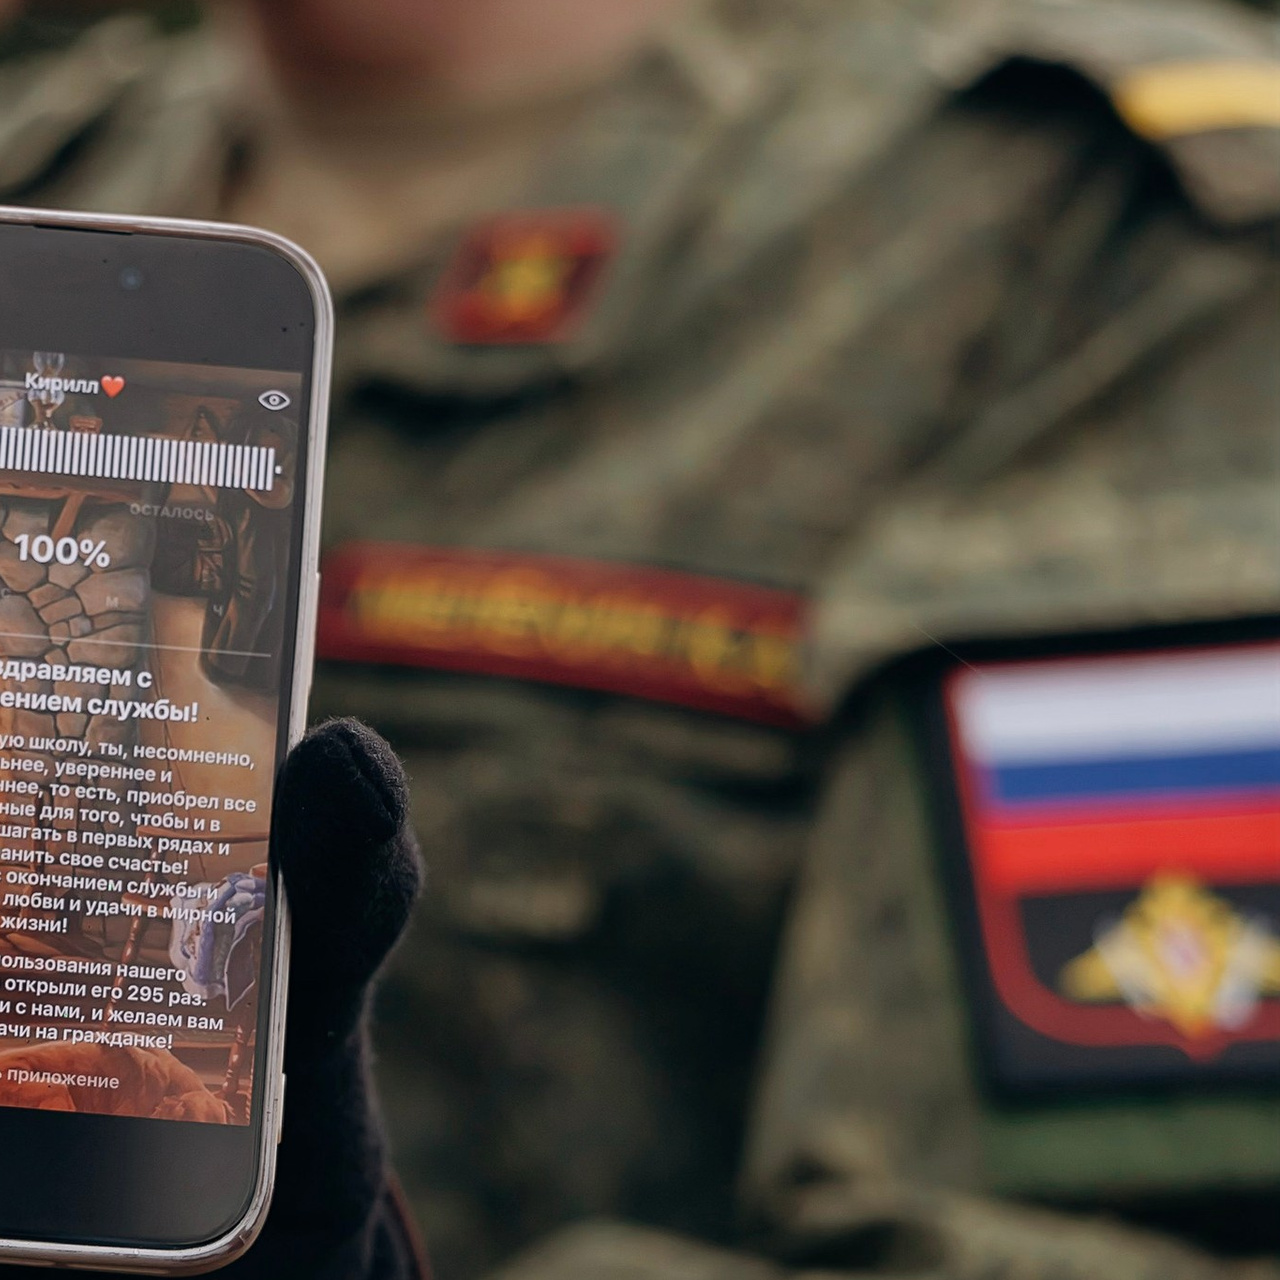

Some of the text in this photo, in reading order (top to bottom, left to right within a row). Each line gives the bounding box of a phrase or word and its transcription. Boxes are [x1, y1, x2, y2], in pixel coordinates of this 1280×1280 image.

[25, 372, 99, 395] Кирилл
[14, 533, 111, 568] 100%
[137, 671, 152, 688] с
[87, 697, 198, 722] службы!
[29, 736, 92, 757] школу,
[98, 742, 128, 759] ты,
[133, 745, 255, 770] несомненно,
[55, 761, 156, 782] увереннее
[160, 771, 172, 782] и
[49, 784, 70, 797] то
[75, 787, 121, 804] есть,
[126, 789, 219, 810] приобрел
[223, 798, 256, 812] все
[39, 805, 74, 819] для
[79, 808, 125, 827] того,
[130, 812, 188, 829] чтобы
[193, 818, 205, 830] и
[209, 820, 220, 832] в
[67, 830, 78, 842] в
[82, 831, 153, 850] первых
[158, 837, 214, 855] рядах
[218, 843, 230, 855] и
[59, 852, 104, 868] свое
[108, 856, 188, 875] счастье!
[6, 871, 122, 892] окончанием
[126, 880, 202, 899] службы
[207, 888, 218, 900] и
[2, 891, 65, 910] любви
[69, 899, 81, 911] и
[85, 900, 142, 917] удачи
[147, 905, 158, 918] в
[163, 906, 236, 924] мирной
[0, 915, 68, 933] жизни!
[116, 964, 187, 982] нашего
[5, 978, 86, 997] открыли
[91, 985, 123, 1000] его
[127, 985, 164, 1003] 295
[168, 992, 207, 1007] раз.
[15, 1002, 27, 1015] с
[31, 1003, 86, 1022] нами,
[91, 1008, 103, 1020] и
[108, 1009, 182, 1027] желаем
[187, 1016, 224, 1030] вам
[35, 1027, 58, 1040] на
[63, 1028, 173, 1049] гражданке!
[7, 1068, 120, 1089] приложение
